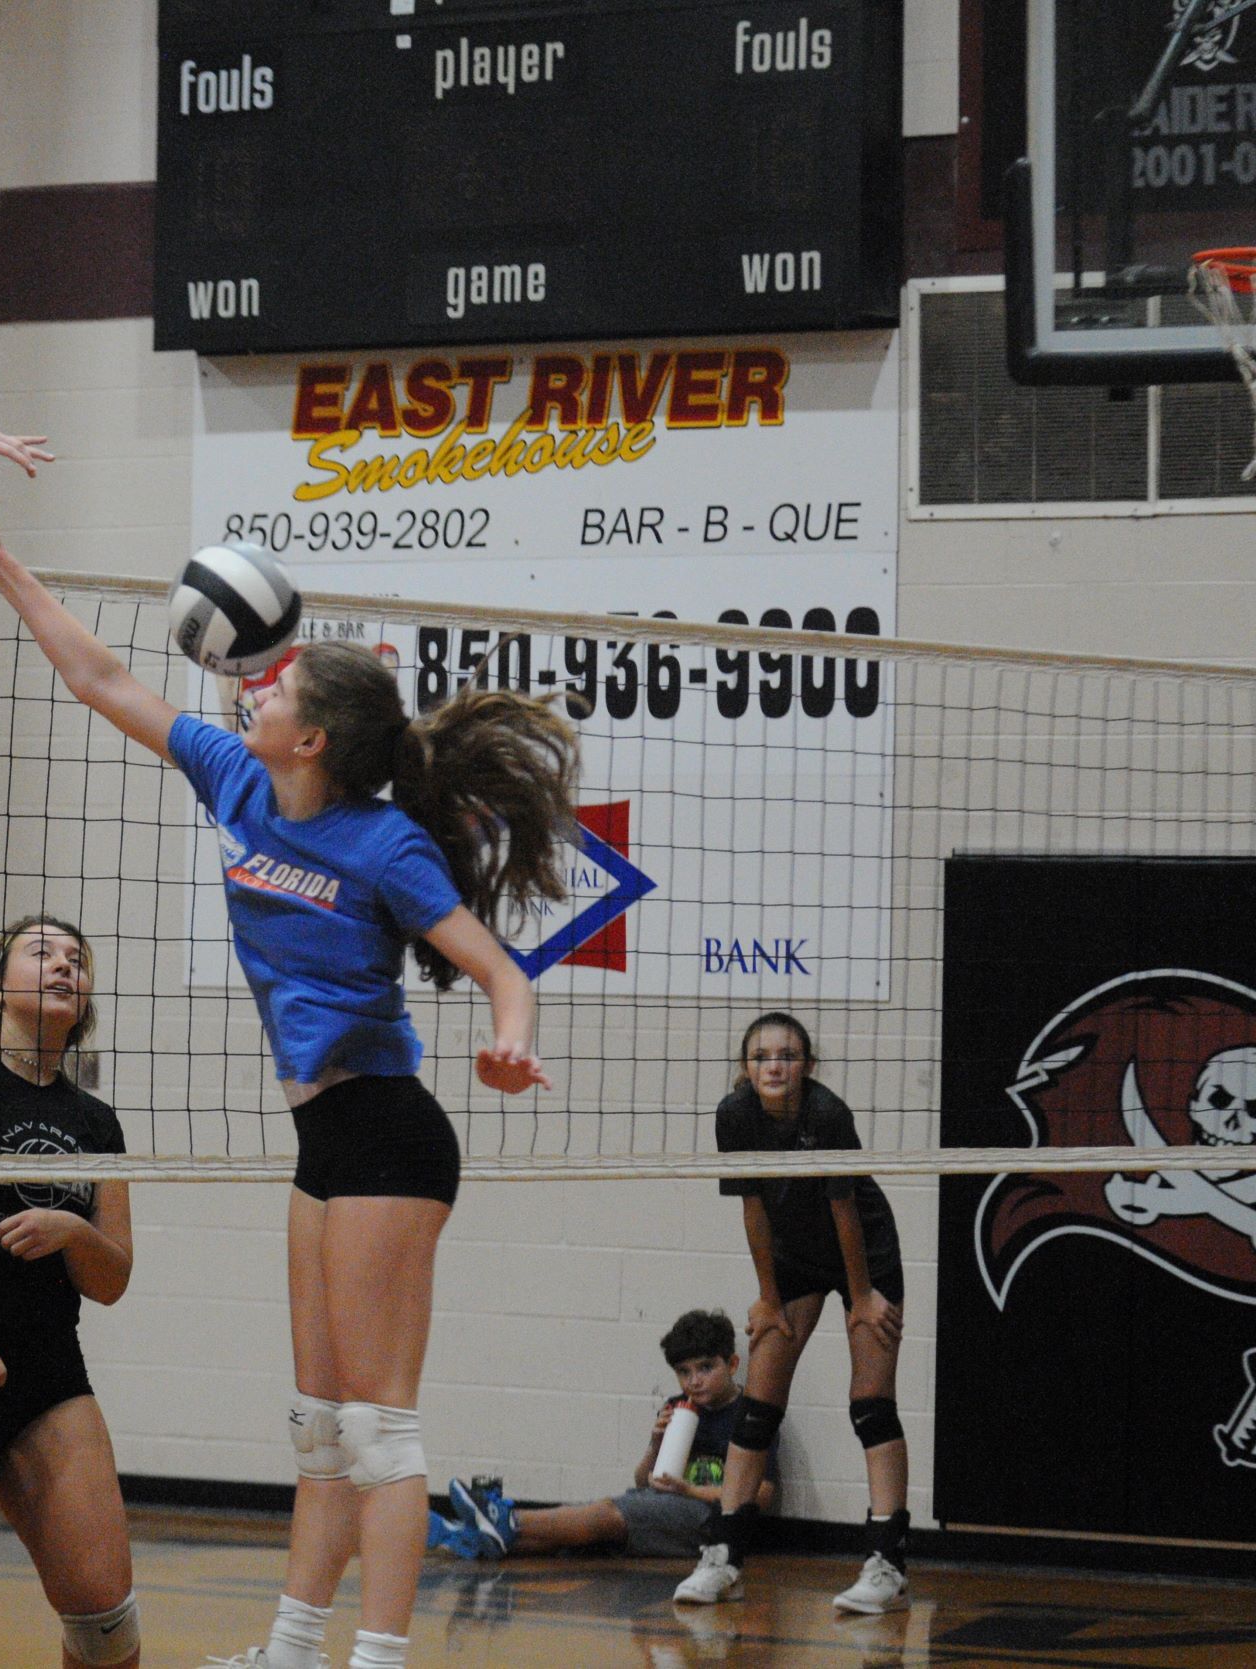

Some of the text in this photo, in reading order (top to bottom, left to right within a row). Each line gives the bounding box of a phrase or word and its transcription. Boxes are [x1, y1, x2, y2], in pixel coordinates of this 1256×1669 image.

[435, 37, 565, 99] player
[734, 17, 832, 74] fouls
[180, 54, 274, 115] fouls
[446, 263, 546, 319] game
[741, 250, 822, 294] won
[188, 277, 260, 320] won
[291, 346, 790, 440] EAST RIVER
[293, 407, 658, 503] Smokehouse
[223, 506, 491, 551] 850-939-2802
[579, 507, 666, 547] BAR
[702, 505, 731, 544] B
[769, 502, 861, 545] QUE
[243, 853, 340, 902] FLORIDA
[704, 938, 811, 975] BANK
